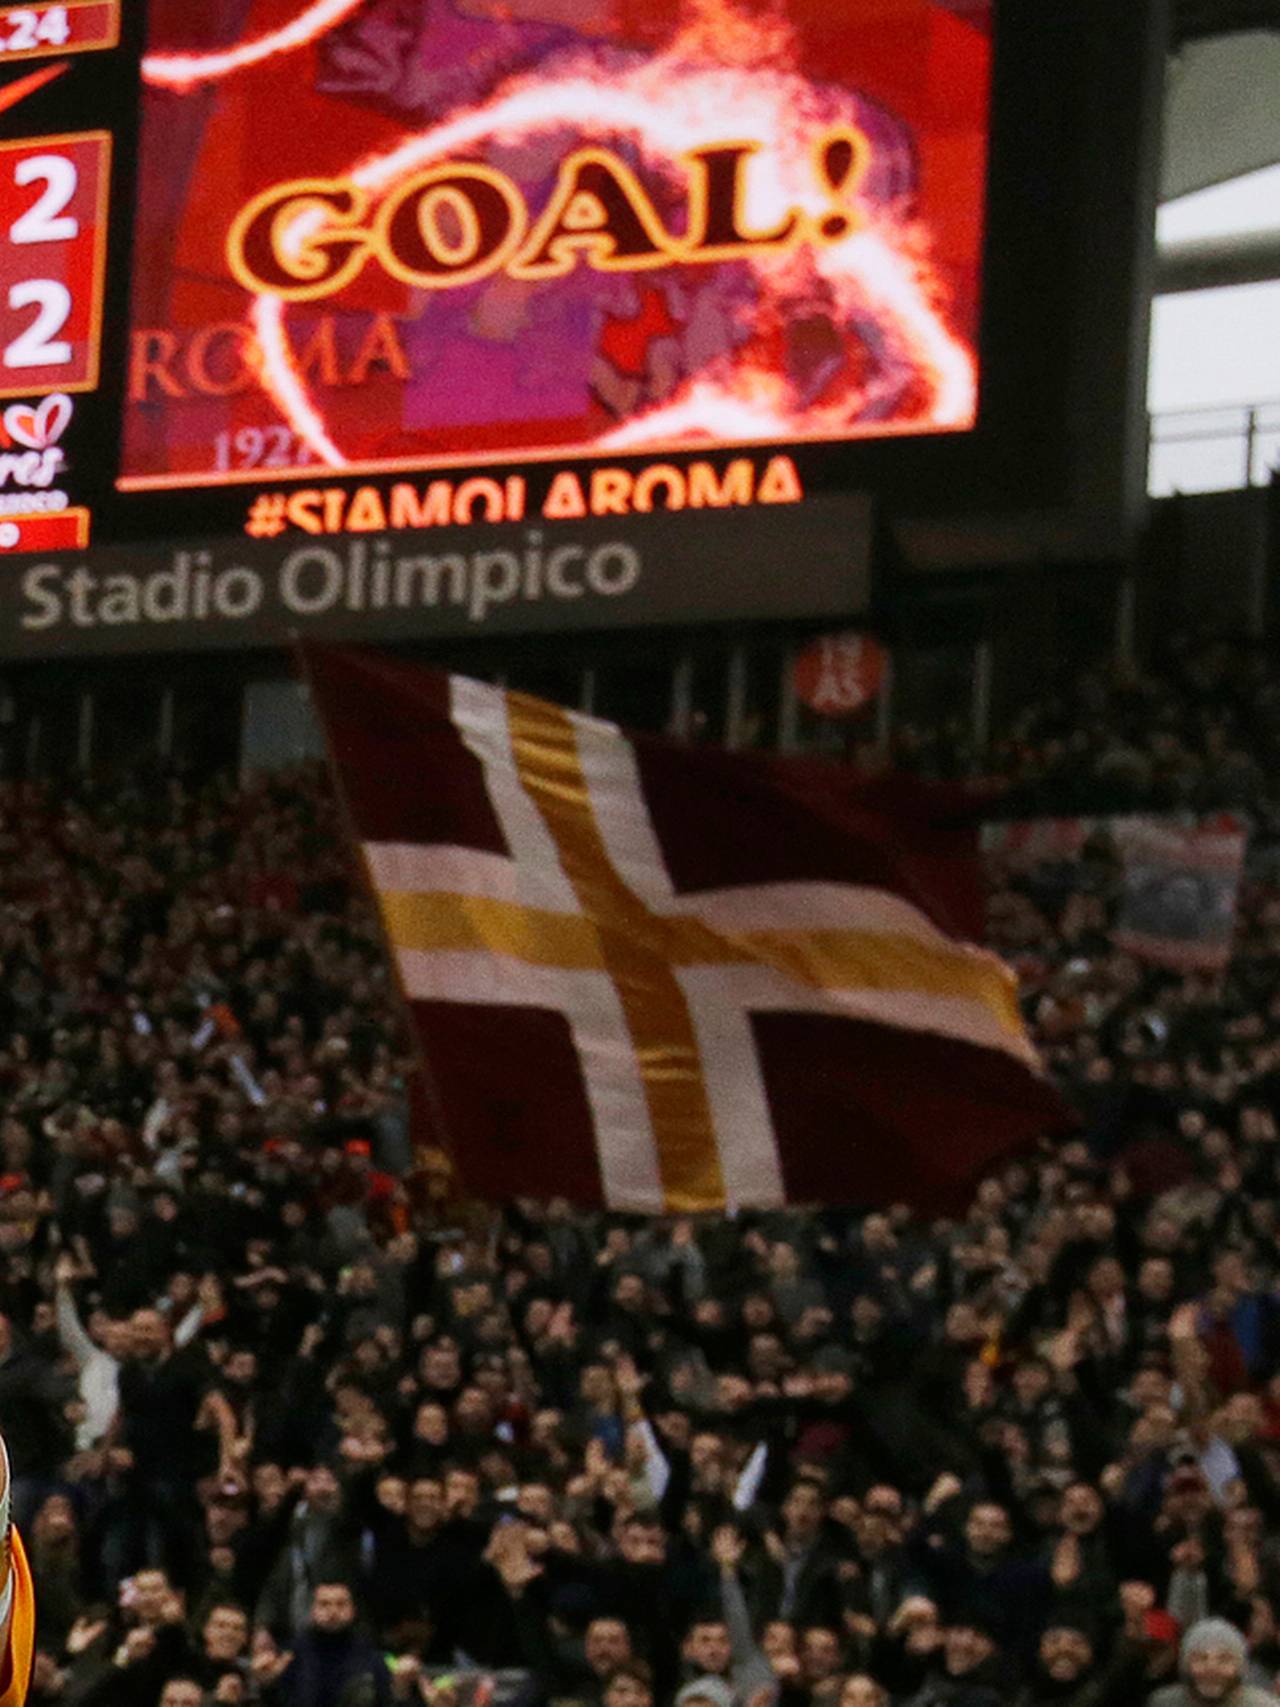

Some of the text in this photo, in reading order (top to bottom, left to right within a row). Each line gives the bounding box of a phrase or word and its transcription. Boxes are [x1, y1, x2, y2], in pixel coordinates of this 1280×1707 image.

[9, 155, 79, 244] 2
[226, 125, 868, 302] GOAL!
[2, 279, 72, 368] 2
[21, 533, 642, 629] Stadio Olimpico
